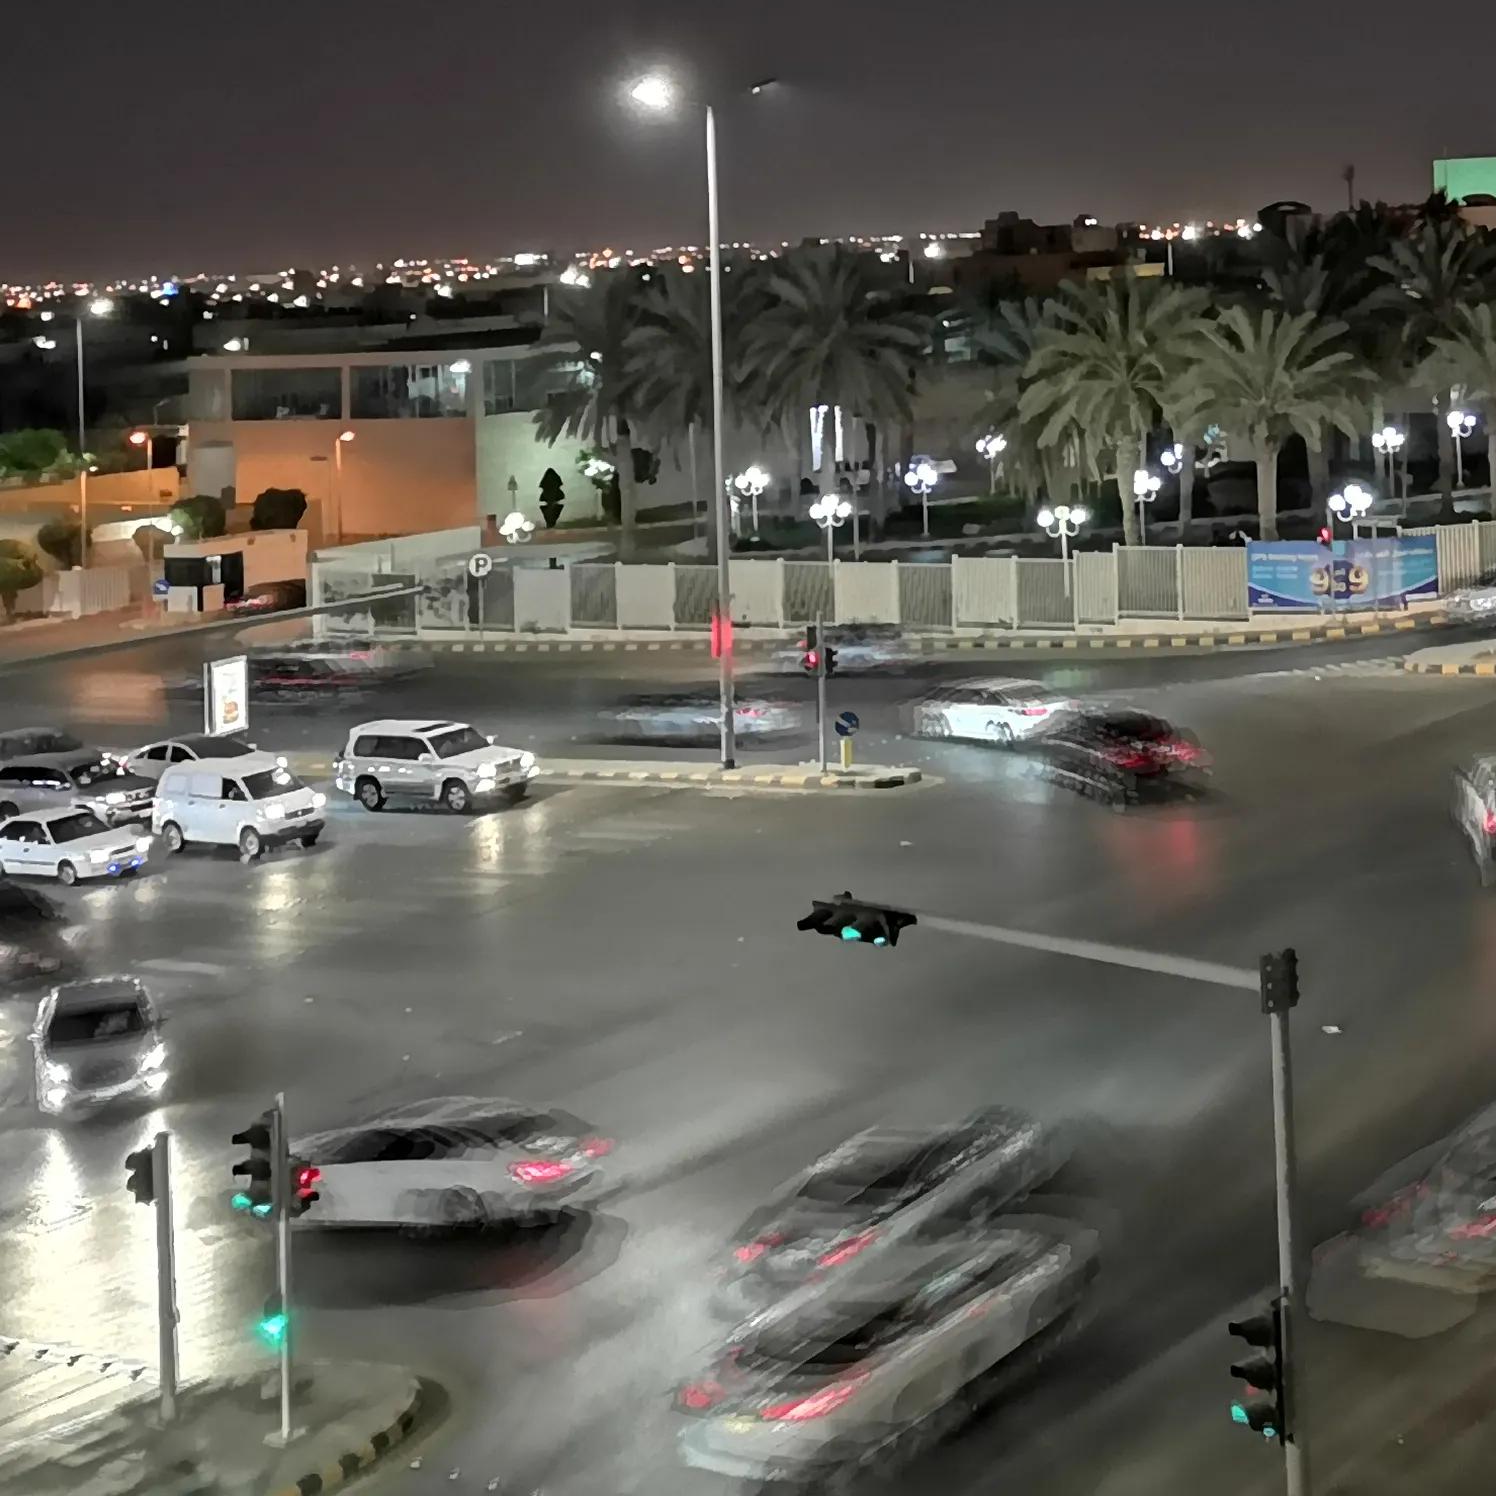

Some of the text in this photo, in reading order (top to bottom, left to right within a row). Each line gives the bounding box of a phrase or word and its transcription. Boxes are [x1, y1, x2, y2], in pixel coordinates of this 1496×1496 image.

[474, 557, 489, 573] P
[1311, 567, 1330, 595] 9
[1348, 566, 1369, 595] 9
